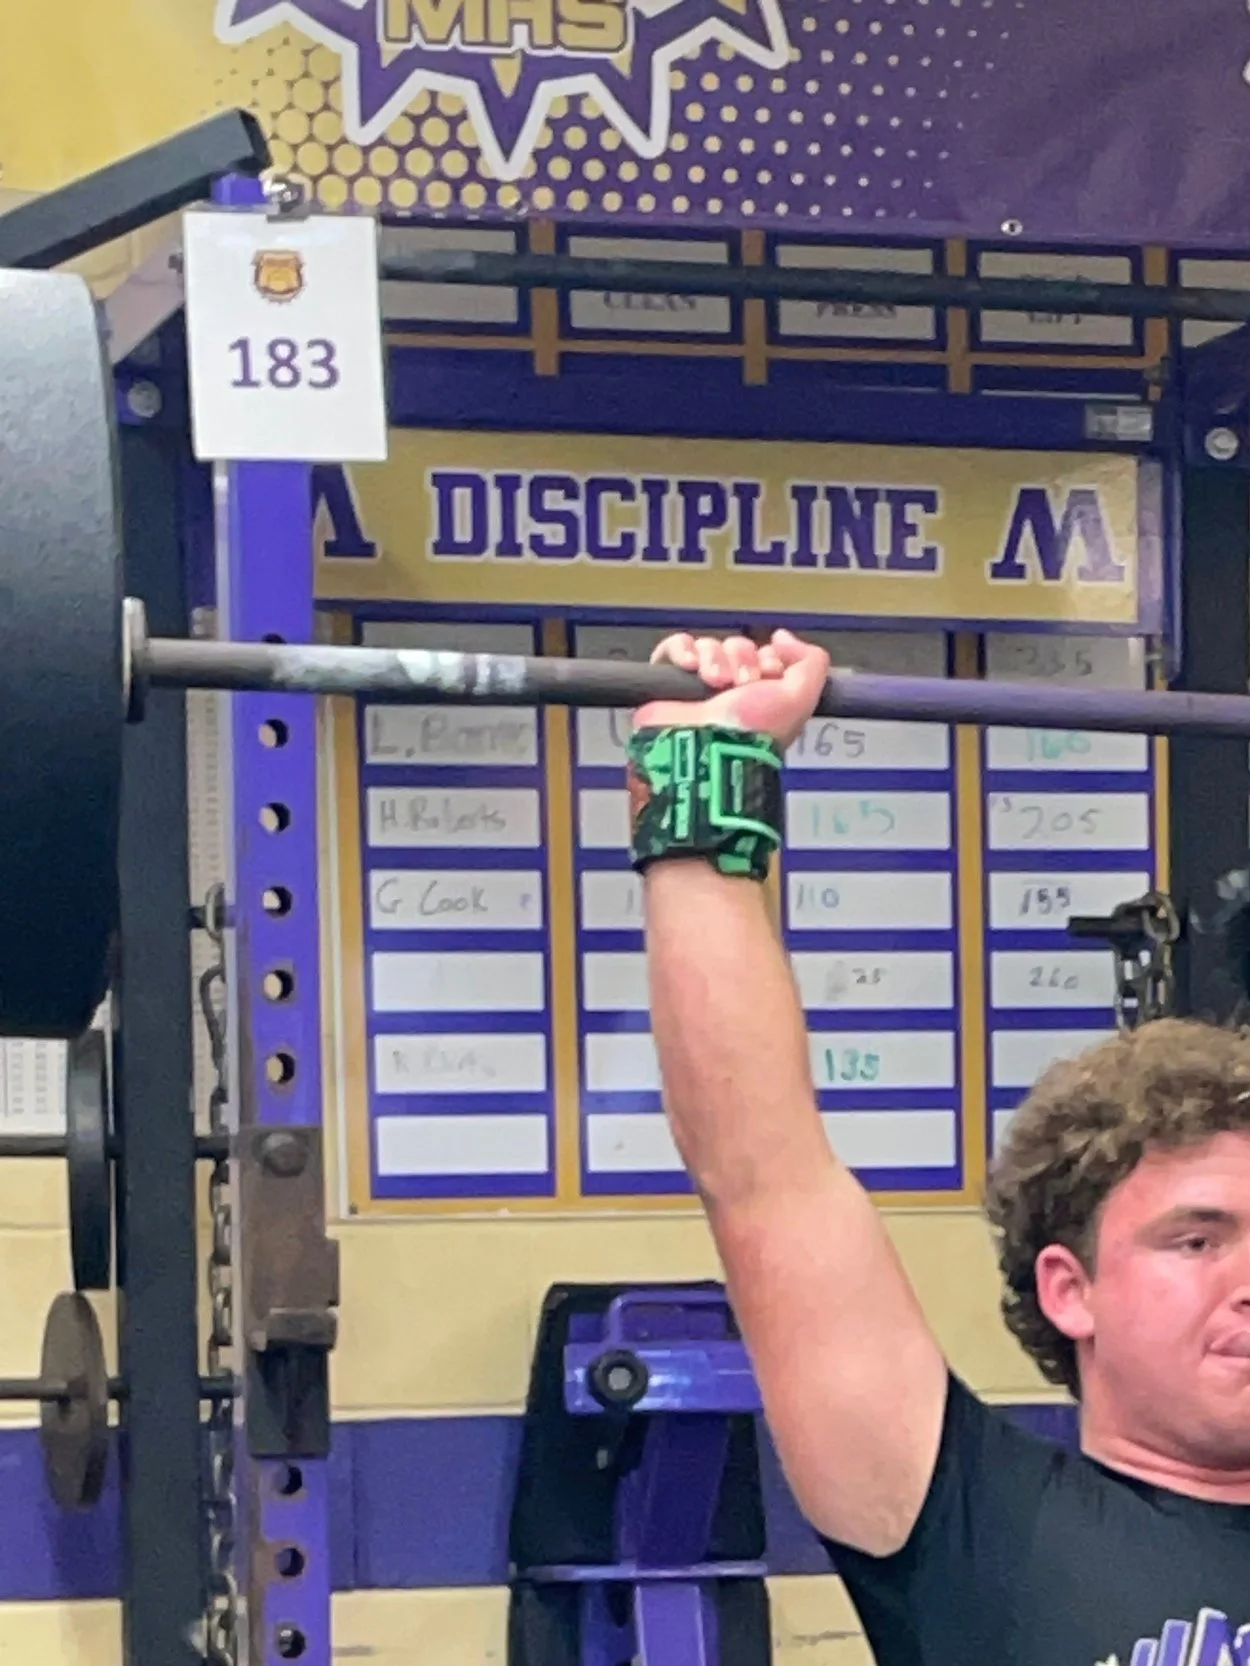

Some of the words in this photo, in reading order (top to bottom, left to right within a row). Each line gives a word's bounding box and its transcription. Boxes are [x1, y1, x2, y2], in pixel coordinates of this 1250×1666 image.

[383, 0, 628, 52] MHS
[228, 337, 341, 389] 183
[430, 473, 938, 572] DISCIPLINE
[1019, 805, 1102, 841] 205
